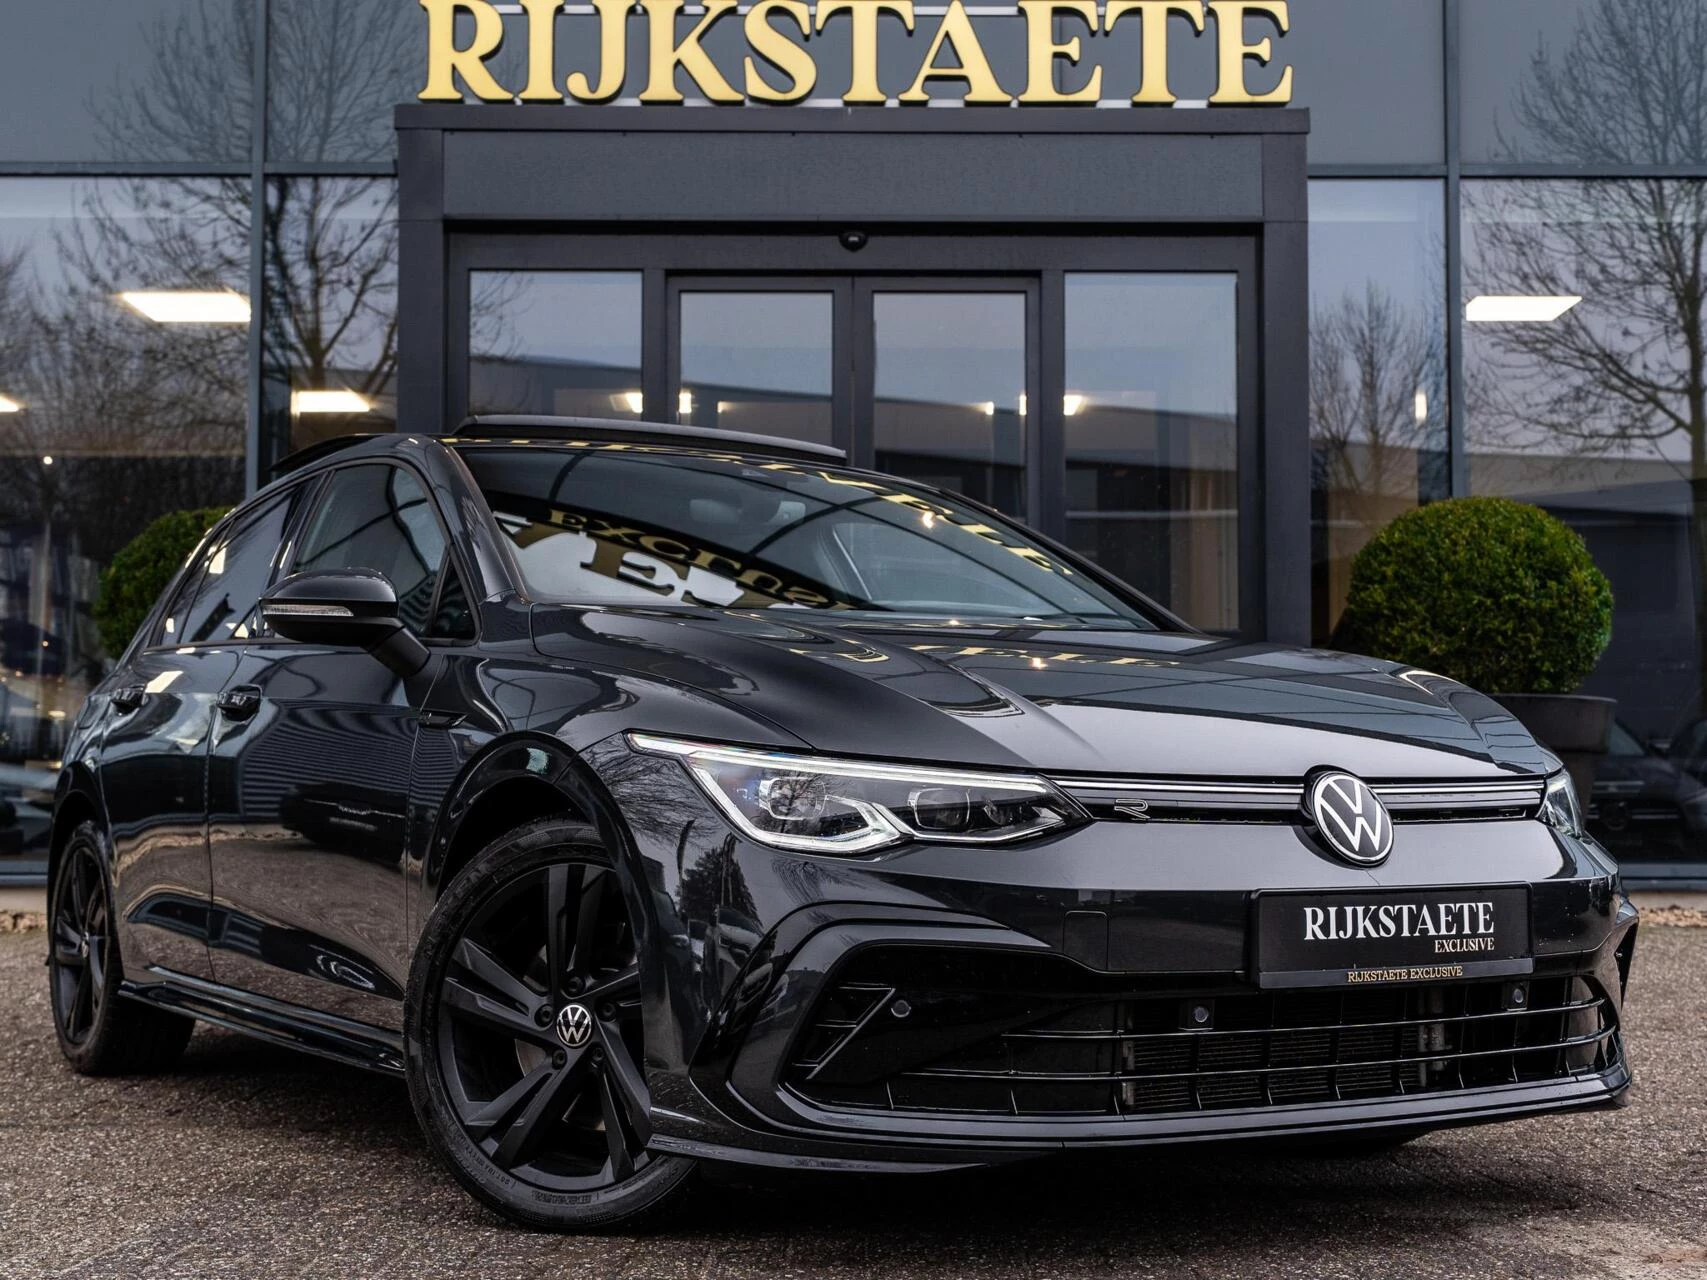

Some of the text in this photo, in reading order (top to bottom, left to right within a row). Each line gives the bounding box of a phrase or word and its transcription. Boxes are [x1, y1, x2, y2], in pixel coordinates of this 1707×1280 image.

[417, 0, 1293, 106] RIJKSTAETE
[1303, 902, 1495, 940] RIJKSTAETE
[1434, 937, 1495, 953] EXCLUSIVE
[1347, 966, 1463, 983] RIJKSTAETE EXCLUSIVE
